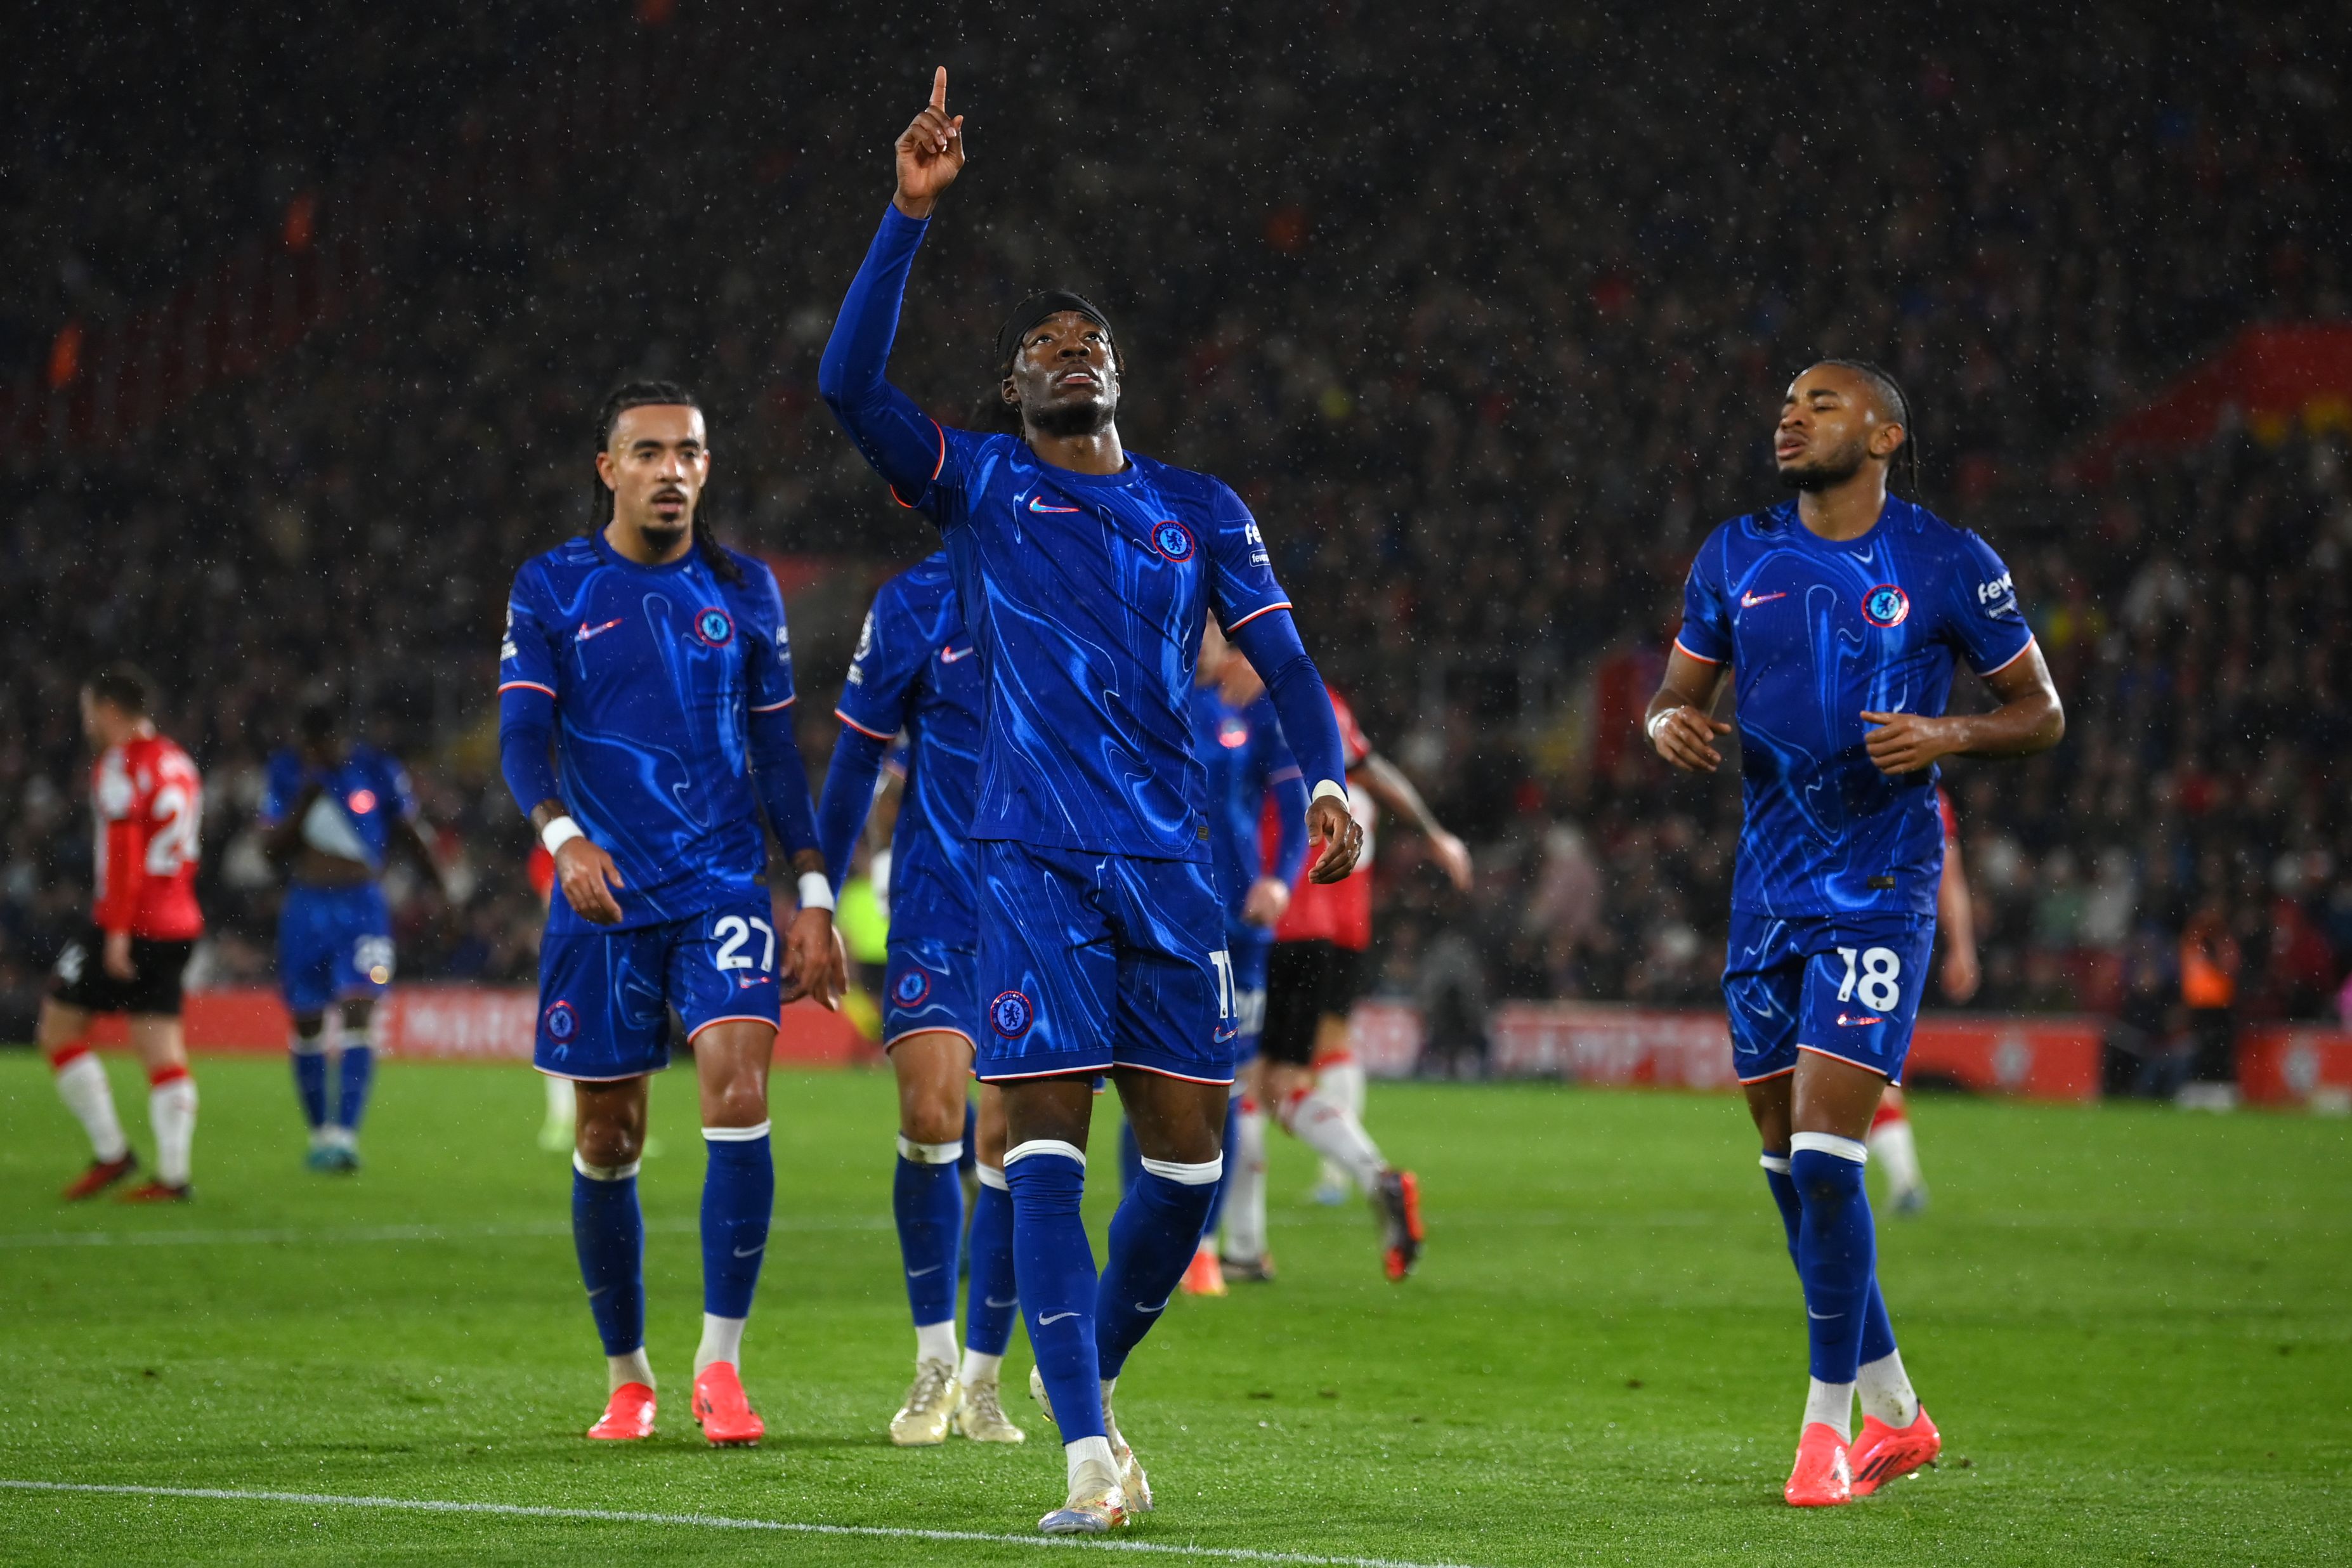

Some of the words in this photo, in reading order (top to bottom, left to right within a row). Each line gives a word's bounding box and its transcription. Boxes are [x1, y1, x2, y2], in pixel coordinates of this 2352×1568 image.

[714, 914, 775, 973] 27
[1208, 950, 1238, 1019] 11
[1836, 946, 1900, 1012] 18
